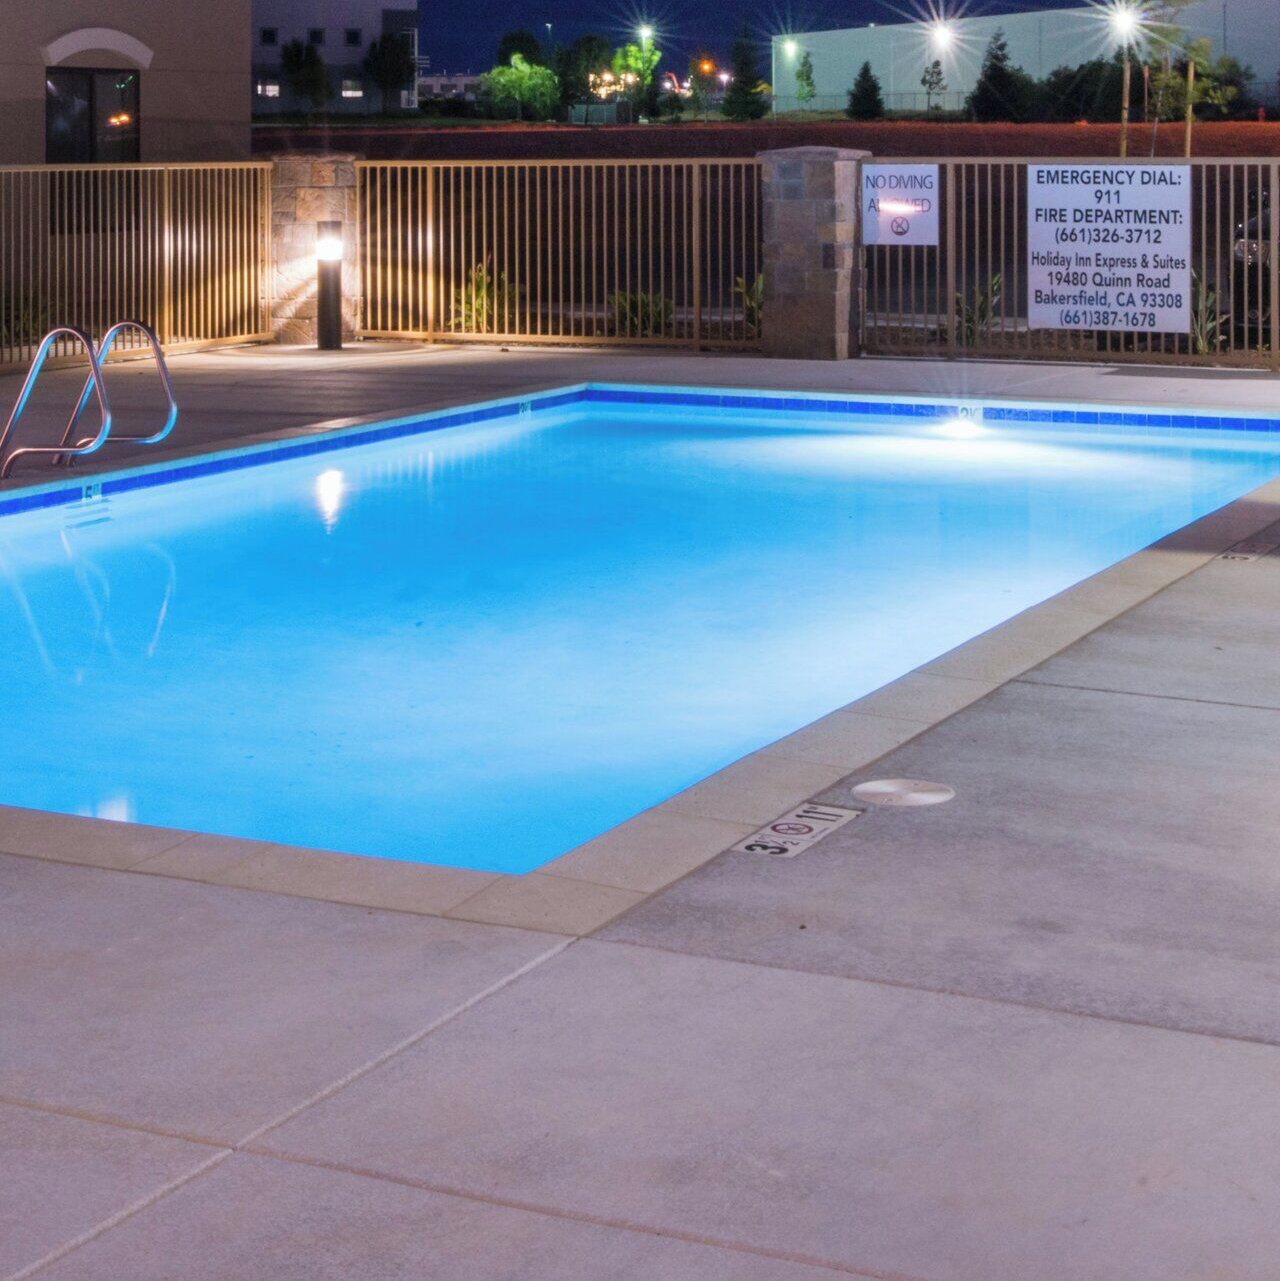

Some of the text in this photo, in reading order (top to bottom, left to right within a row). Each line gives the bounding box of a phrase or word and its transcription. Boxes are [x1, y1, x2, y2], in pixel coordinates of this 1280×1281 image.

[865, 174, 933, 189] NO DIVING
[1036, 169, 1181, 186] EMERGENCY DIAL:
[1094, 190, 1120, 204] 911
[1035, 208, 1183, 225] FIRE DEPARTMENT:
[1055, 228, 1162, 245] (661)326-3712
[1031, 251, 1186, 271] Holiday Inn Express & Suites
[1047, 272, 1170, 289] 19480 Quinn Road
[1034, 289, 1182, 308] Bakersfield, CA 93308
[1060, 309, 1156, 328] (661)387-1678
